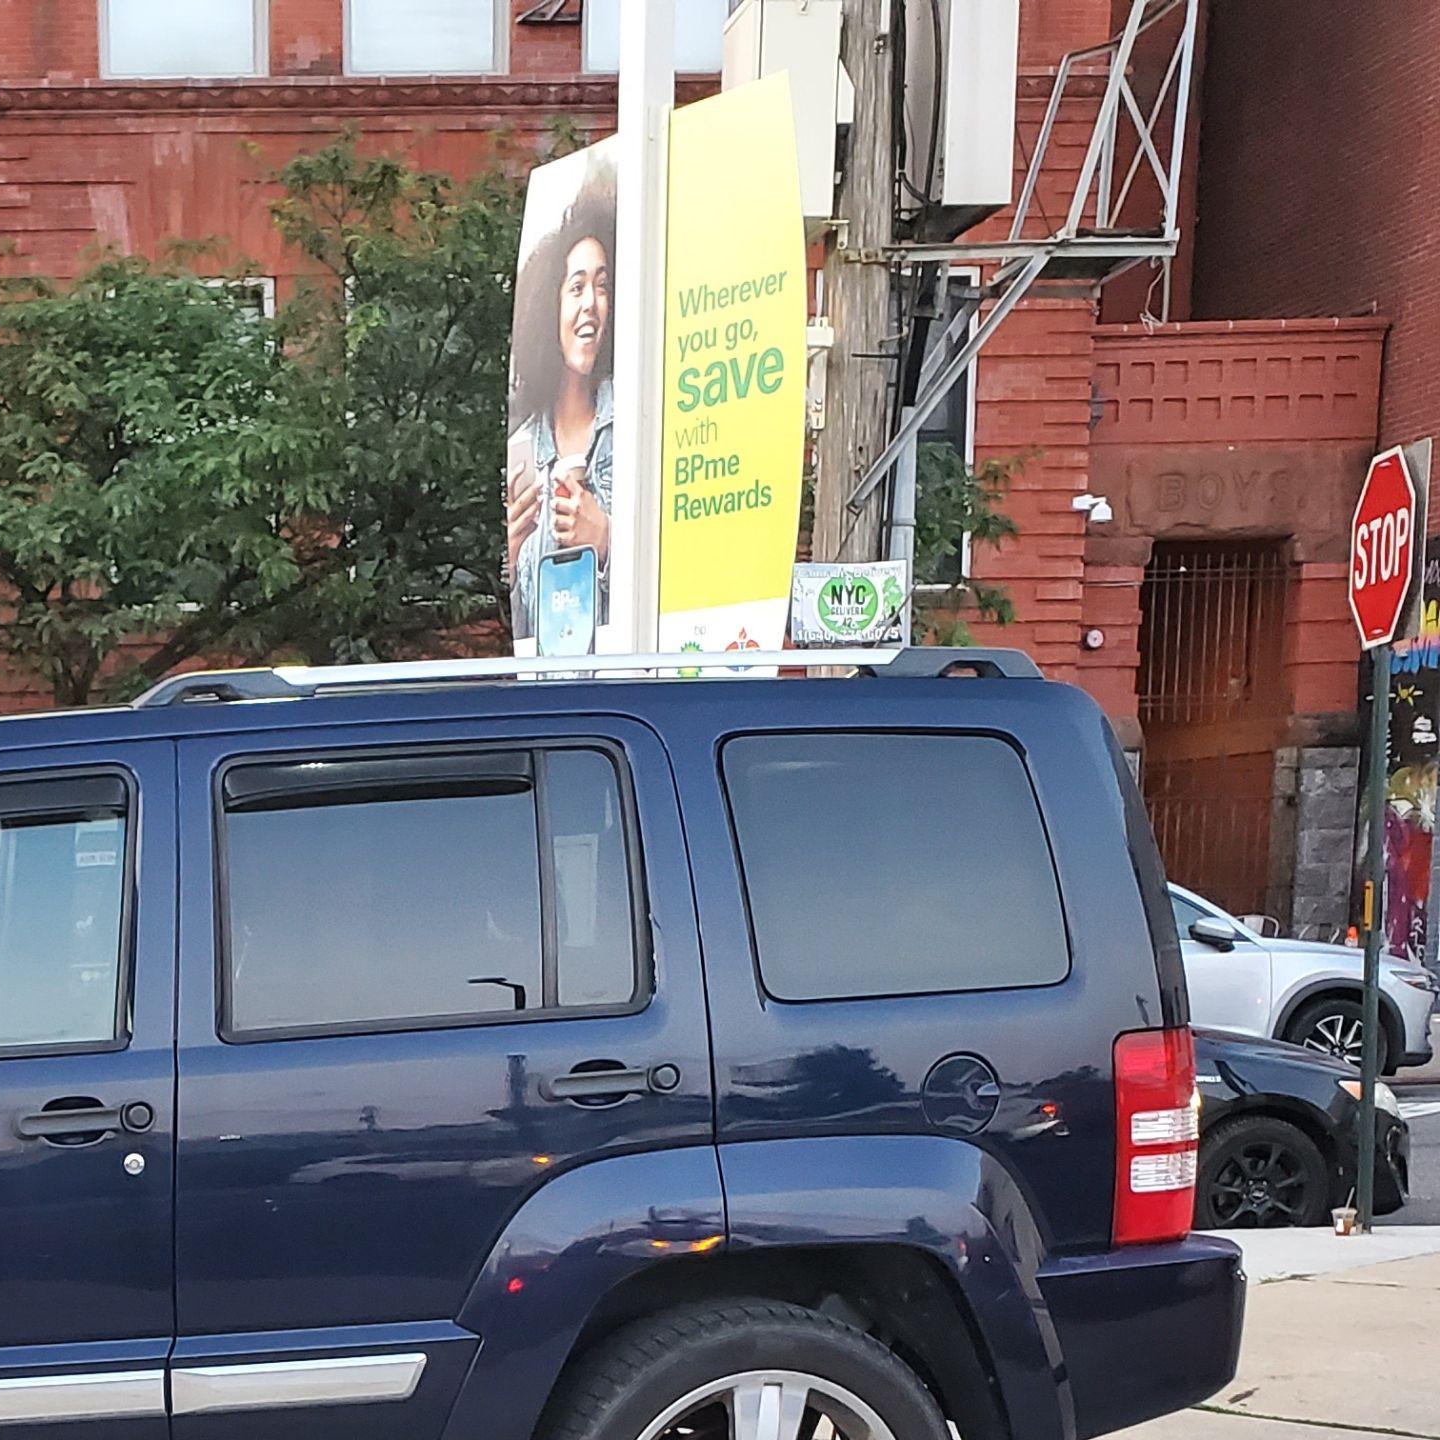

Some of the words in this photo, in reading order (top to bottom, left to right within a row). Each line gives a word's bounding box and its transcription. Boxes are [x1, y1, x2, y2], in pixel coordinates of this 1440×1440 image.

[678, 270, 787, 318] Wherever
[677, 327, 717, 362] you
[725, 318, 758, 351] go,
[677, 347, 784, 412] save
[675, 416, 718, 450] with
[674, 454, 740, 486] BPme
[673, 479, 772, 522] Rewards
[1354, 508, 1409, 590] STOP
[831, 584, 866, 606] NYC
